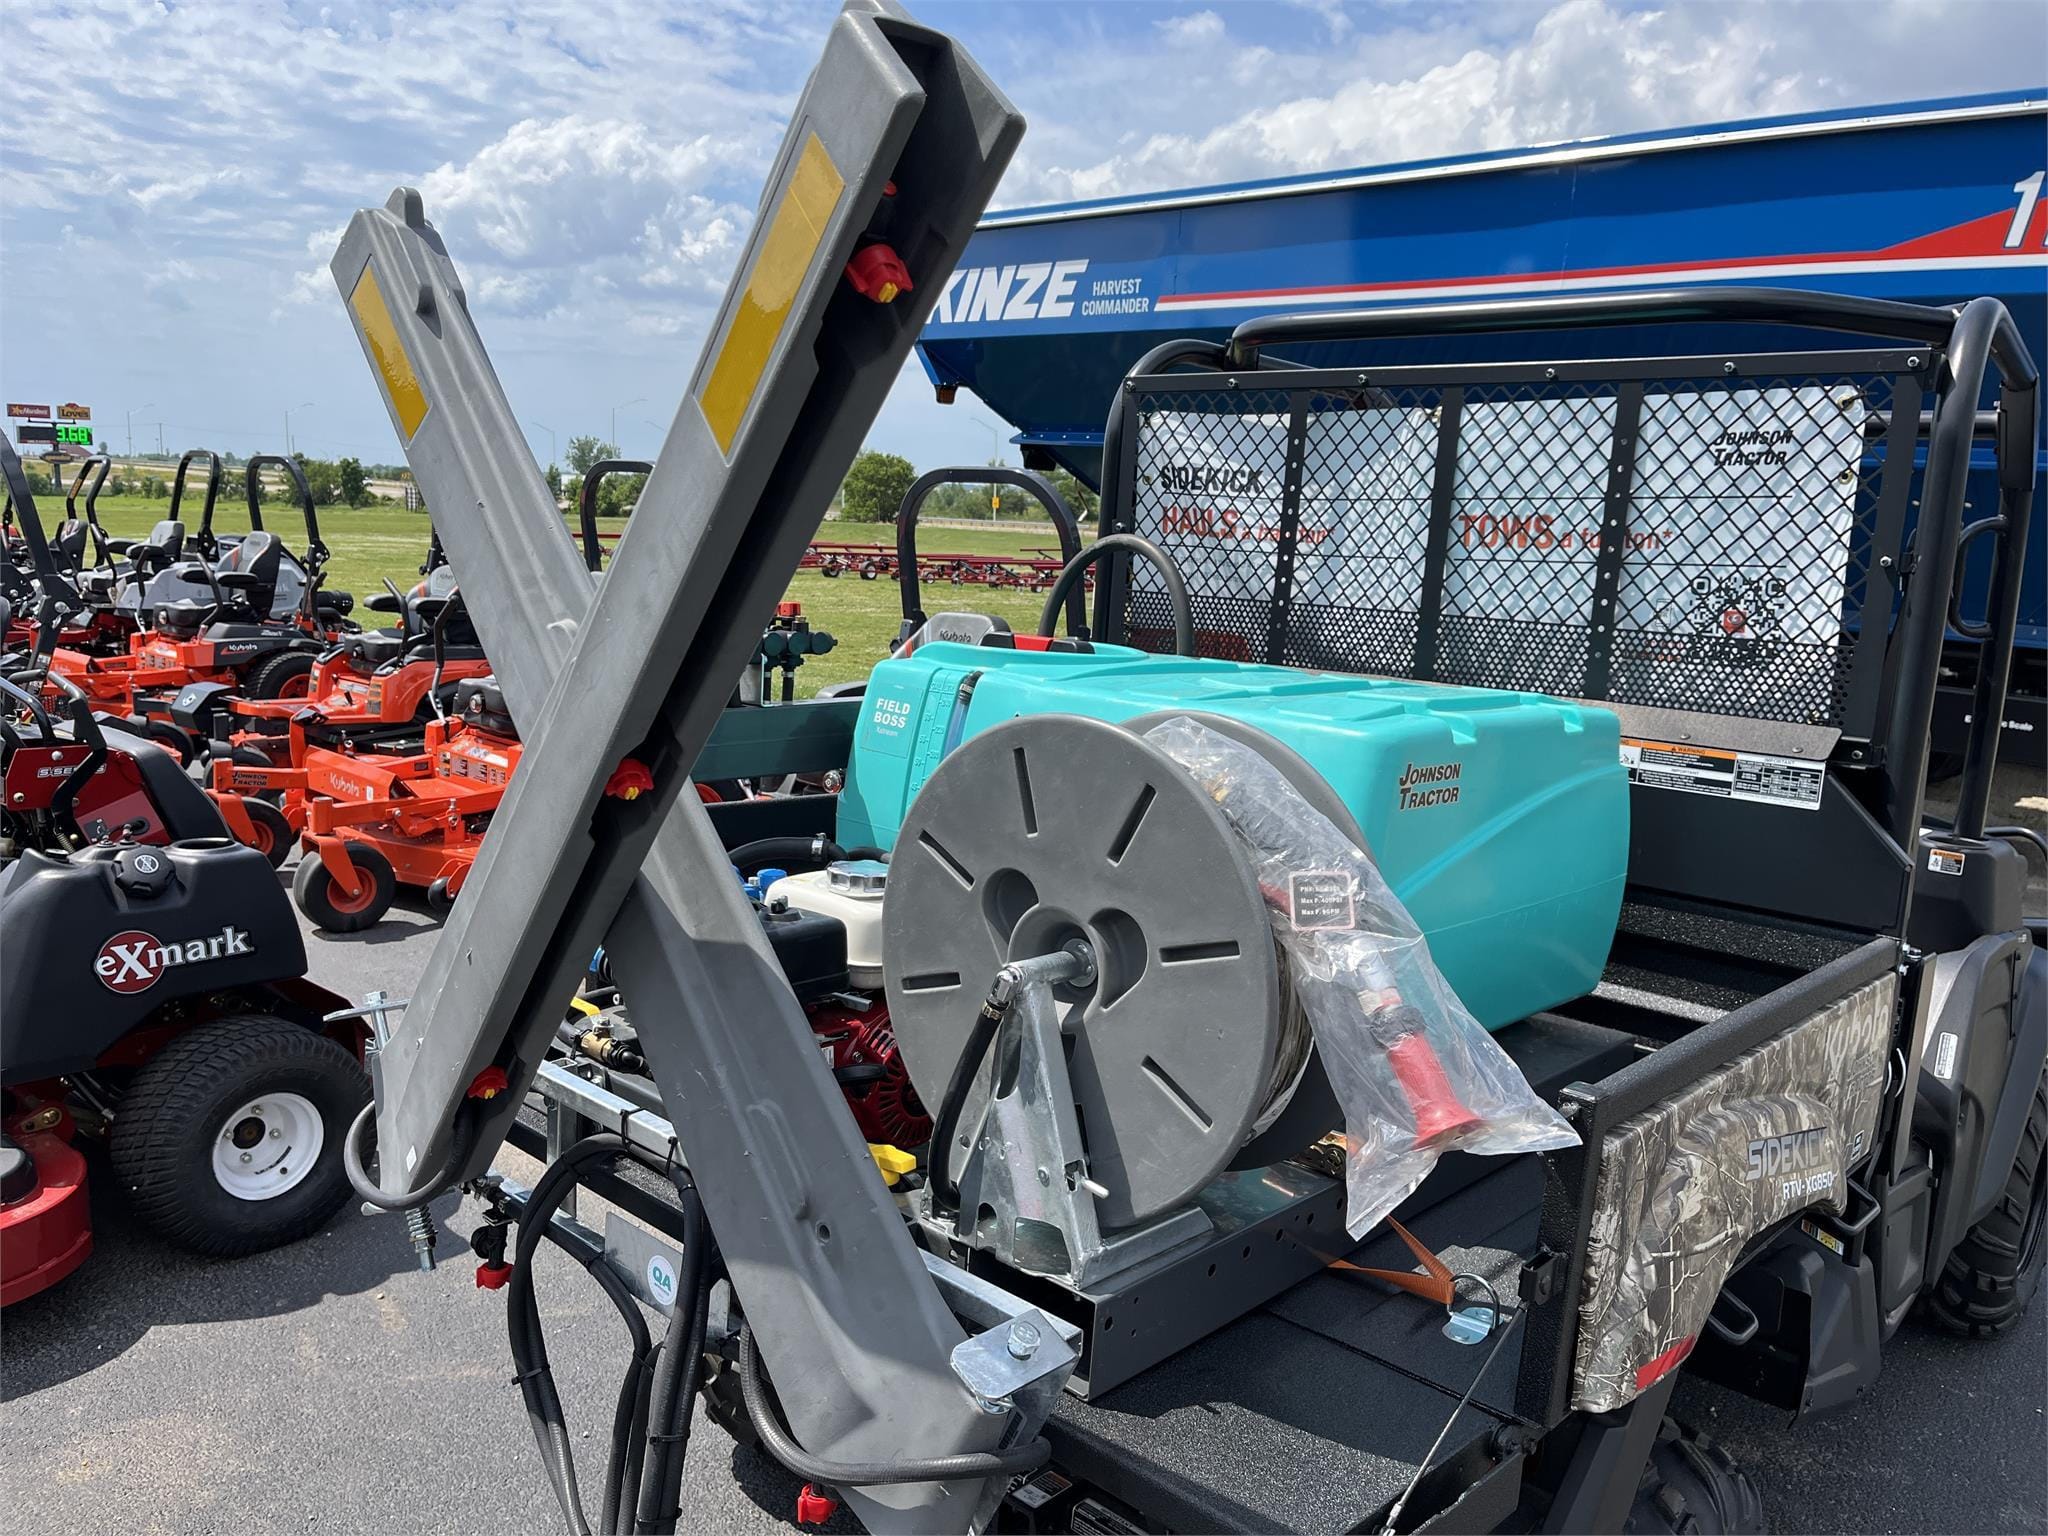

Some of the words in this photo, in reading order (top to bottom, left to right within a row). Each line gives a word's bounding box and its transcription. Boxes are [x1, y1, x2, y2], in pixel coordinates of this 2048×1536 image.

[926, 259, 1089, 324] KINZE
[1093, 278, 1142, 297] HARVEST
[1082, 298, 1150, 316] COMMANDER
[1712, 429, 1793, 446] JOHNSON
[1714, 449, 1787, 466] TRACTOR
[1160, 465, 1263, 494] SIDEKICK
[1162, 506, 1239, 539] HAULS
[1458, 514, 1555, 549] TOWS
[1559, 532, 1572, 548] a
[939, 629, 972, 643] Kubota
[876, 698, 910, 715] FIELD
[873, 711, 906, 729] BOSS
[232, 771, 268, 780] JOHNSON
[232, 778, 267, 787] TRACTOR
[330, 772, 360, 797] Kubota
[1399, 763, 1461, 786] JOHNSON
[1400, 787, 1459, 810] TRACTOR
[1745, 1130, 1829, 1182] SIDEKICK
[652, 1265, 672, 1293] QA
